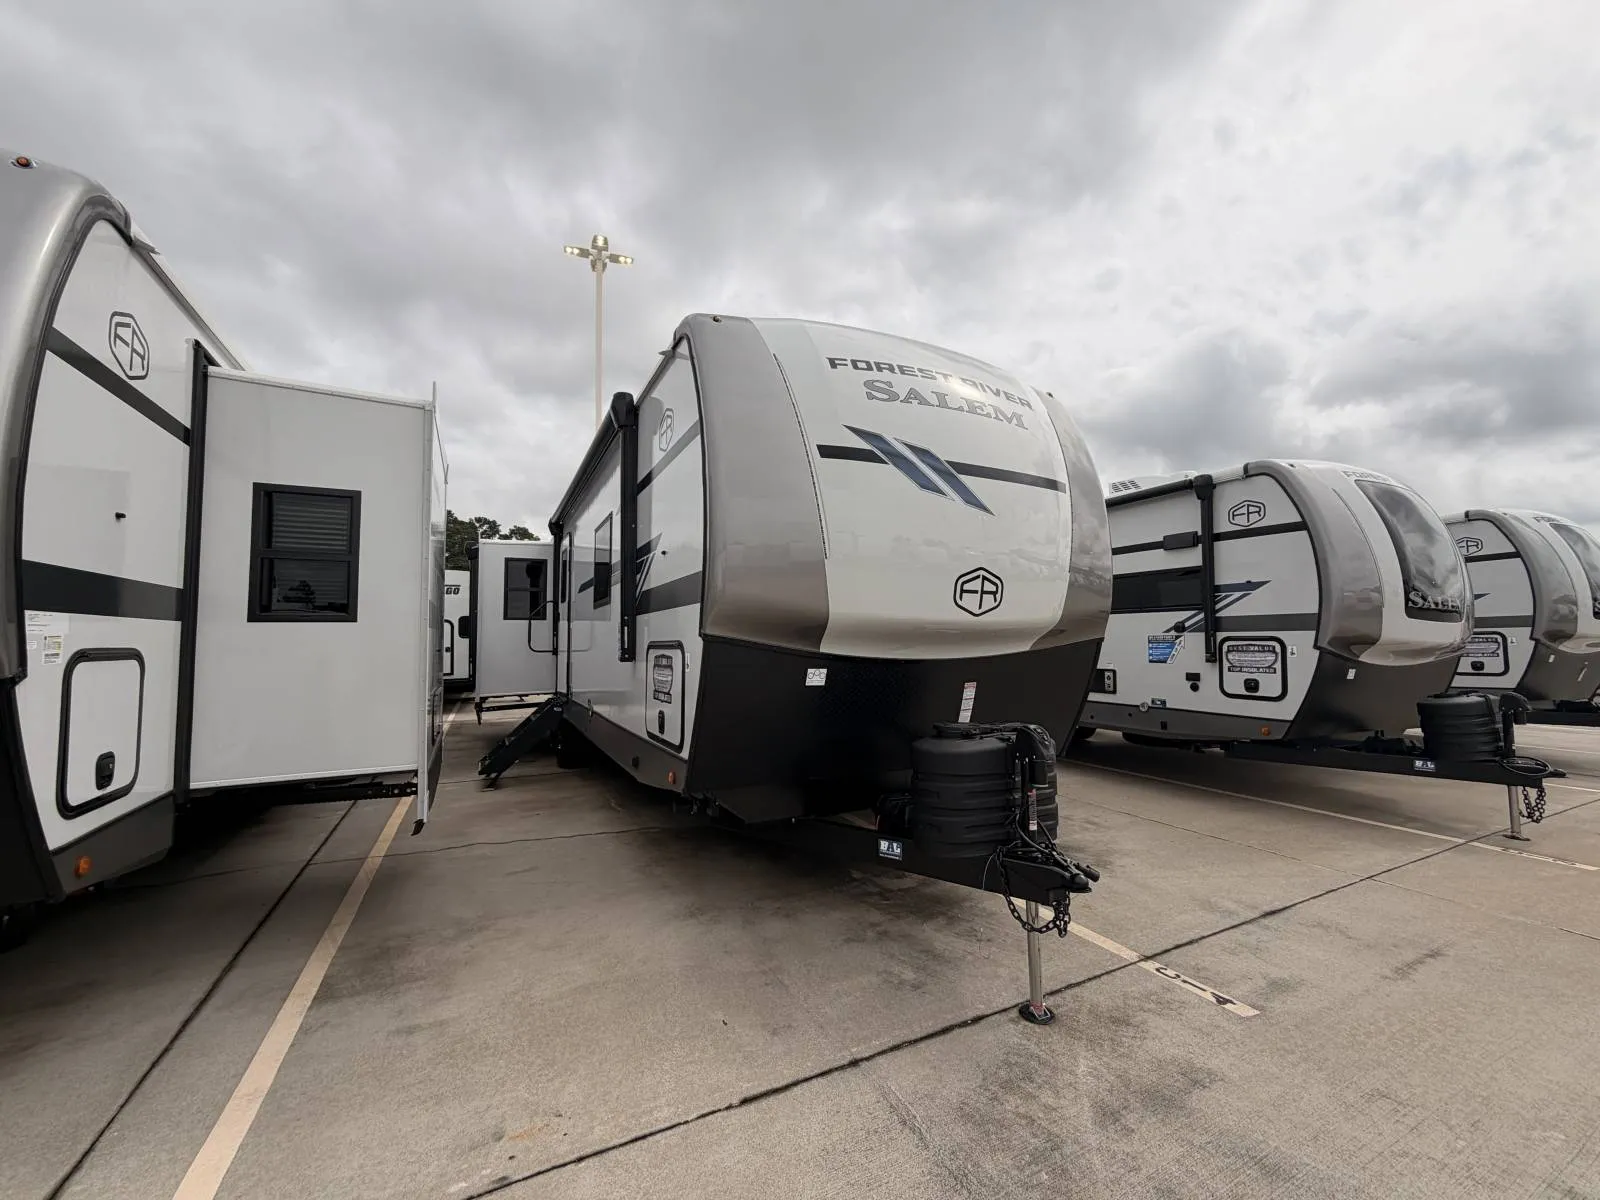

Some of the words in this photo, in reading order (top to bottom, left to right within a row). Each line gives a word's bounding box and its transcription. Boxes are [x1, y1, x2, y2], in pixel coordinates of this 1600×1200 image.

[825, 356, 953, 383] FOREST
[958, 376, 1034, 411] RIVER
[863, 379, 1029, 430] SALEM
